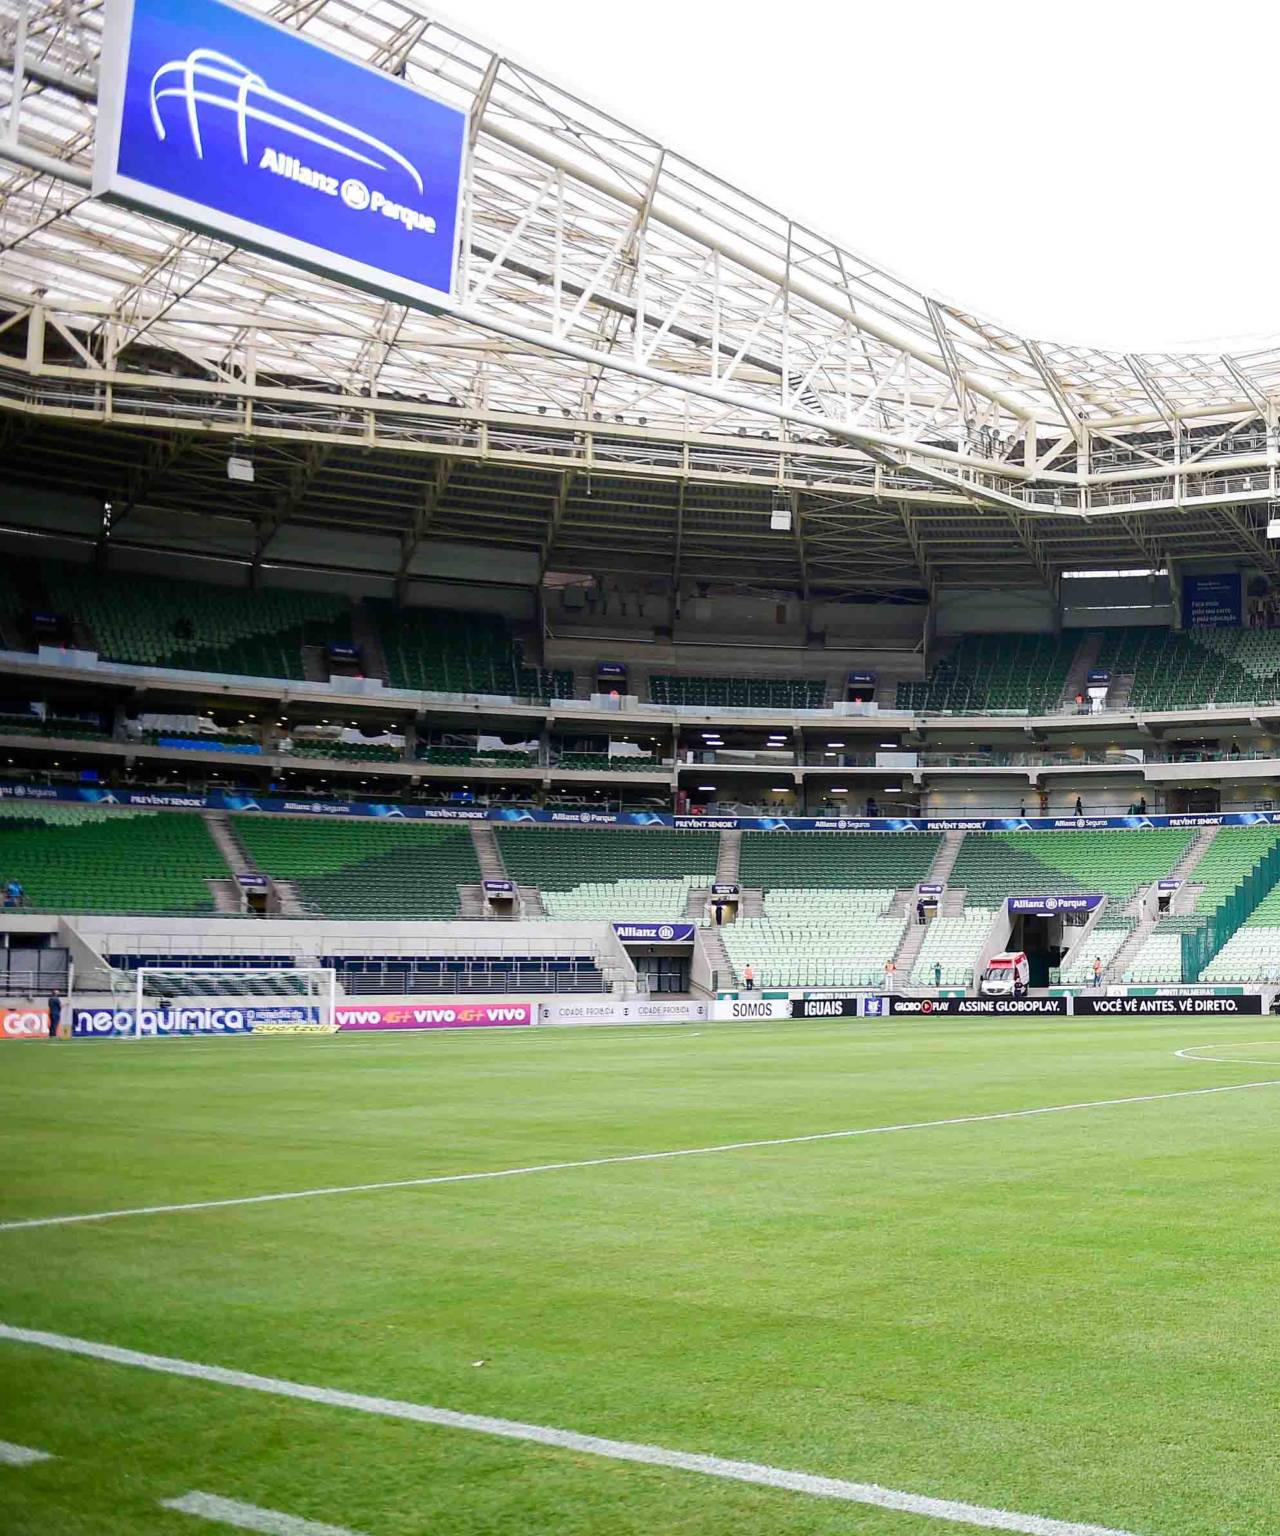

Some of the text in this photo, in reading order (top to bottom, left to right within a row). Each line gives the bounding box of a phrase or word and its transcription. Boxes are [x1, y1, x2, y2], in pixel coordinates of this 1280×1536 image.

[260, 148, 437, 235] Allianz Parque
[552, 812, 617, 823] Allianz Parque
[675, 818, 733, 828] PREVENT SENIOR
[1013, 898, 1087, 909] Allianz Parque
[617, 926, 657, 937] Allianz
[638, 1006, 660, 1014] CIDADE
[732, 1003, 773, 1017] SOMOS
[804, 1001, 843, 1016] IGUAIS
[894, 1000, 1060, 1012] GLOBO PLAY ASSINE GLOBOPLAY.
[1092, 997, 1238, 1012] VOCÊ VÊ ANTES. VÊ DIRETO.
[559, 1008, 583, 1016] CIDADE
[75, 1008, 244, 1034] neo química
